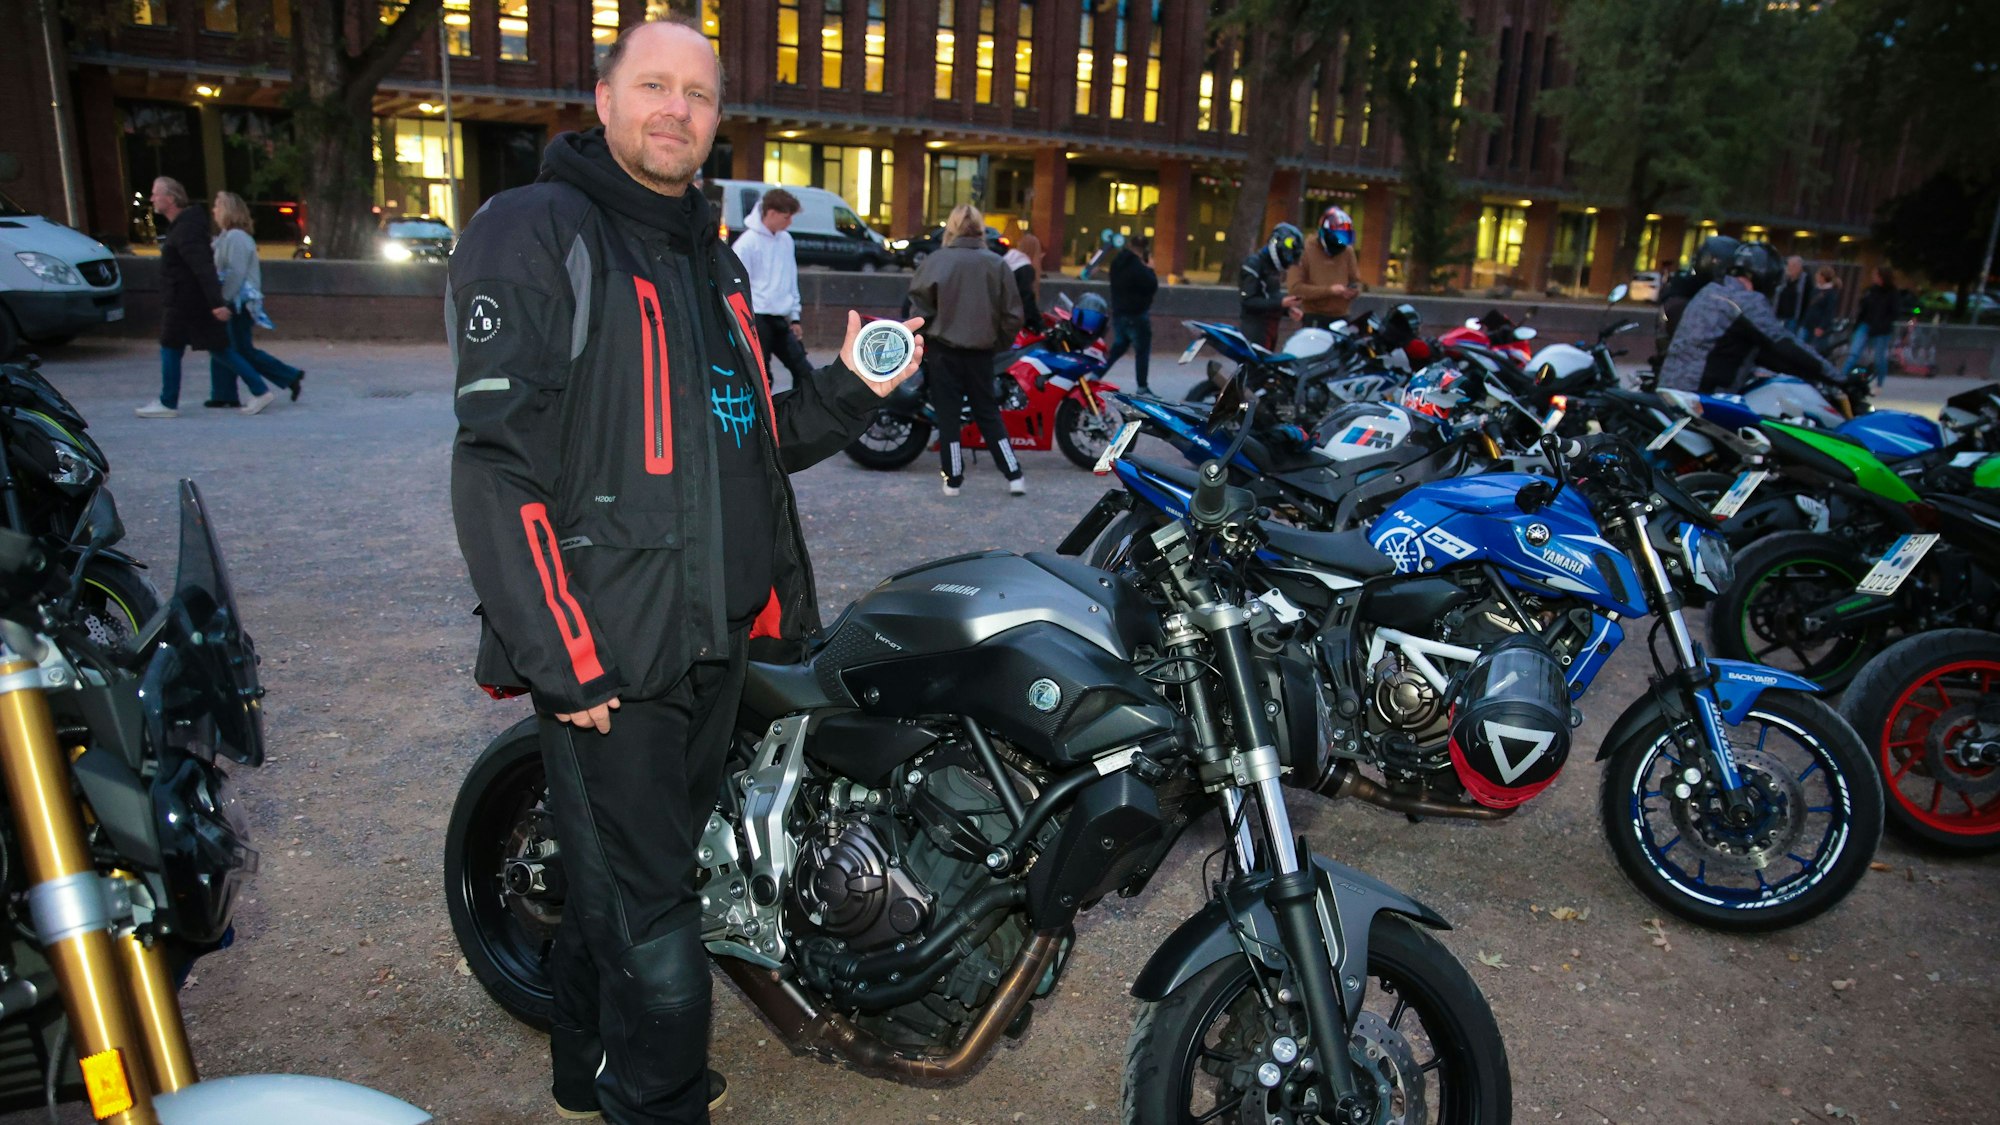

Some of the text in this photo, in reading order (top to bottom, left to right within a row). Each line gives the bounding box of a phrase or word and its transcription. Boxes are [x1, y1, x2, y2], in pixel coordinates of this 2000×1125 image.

[1393, 510, 1427, 529] MT
[1541, 548, 1585, 576] YAMAHA
[930, 583, 981, 597] YAMAHA
[1728, 672, 1778, 685] BACKYARD
[1709, 702, 1738, 774] DUNLOP
